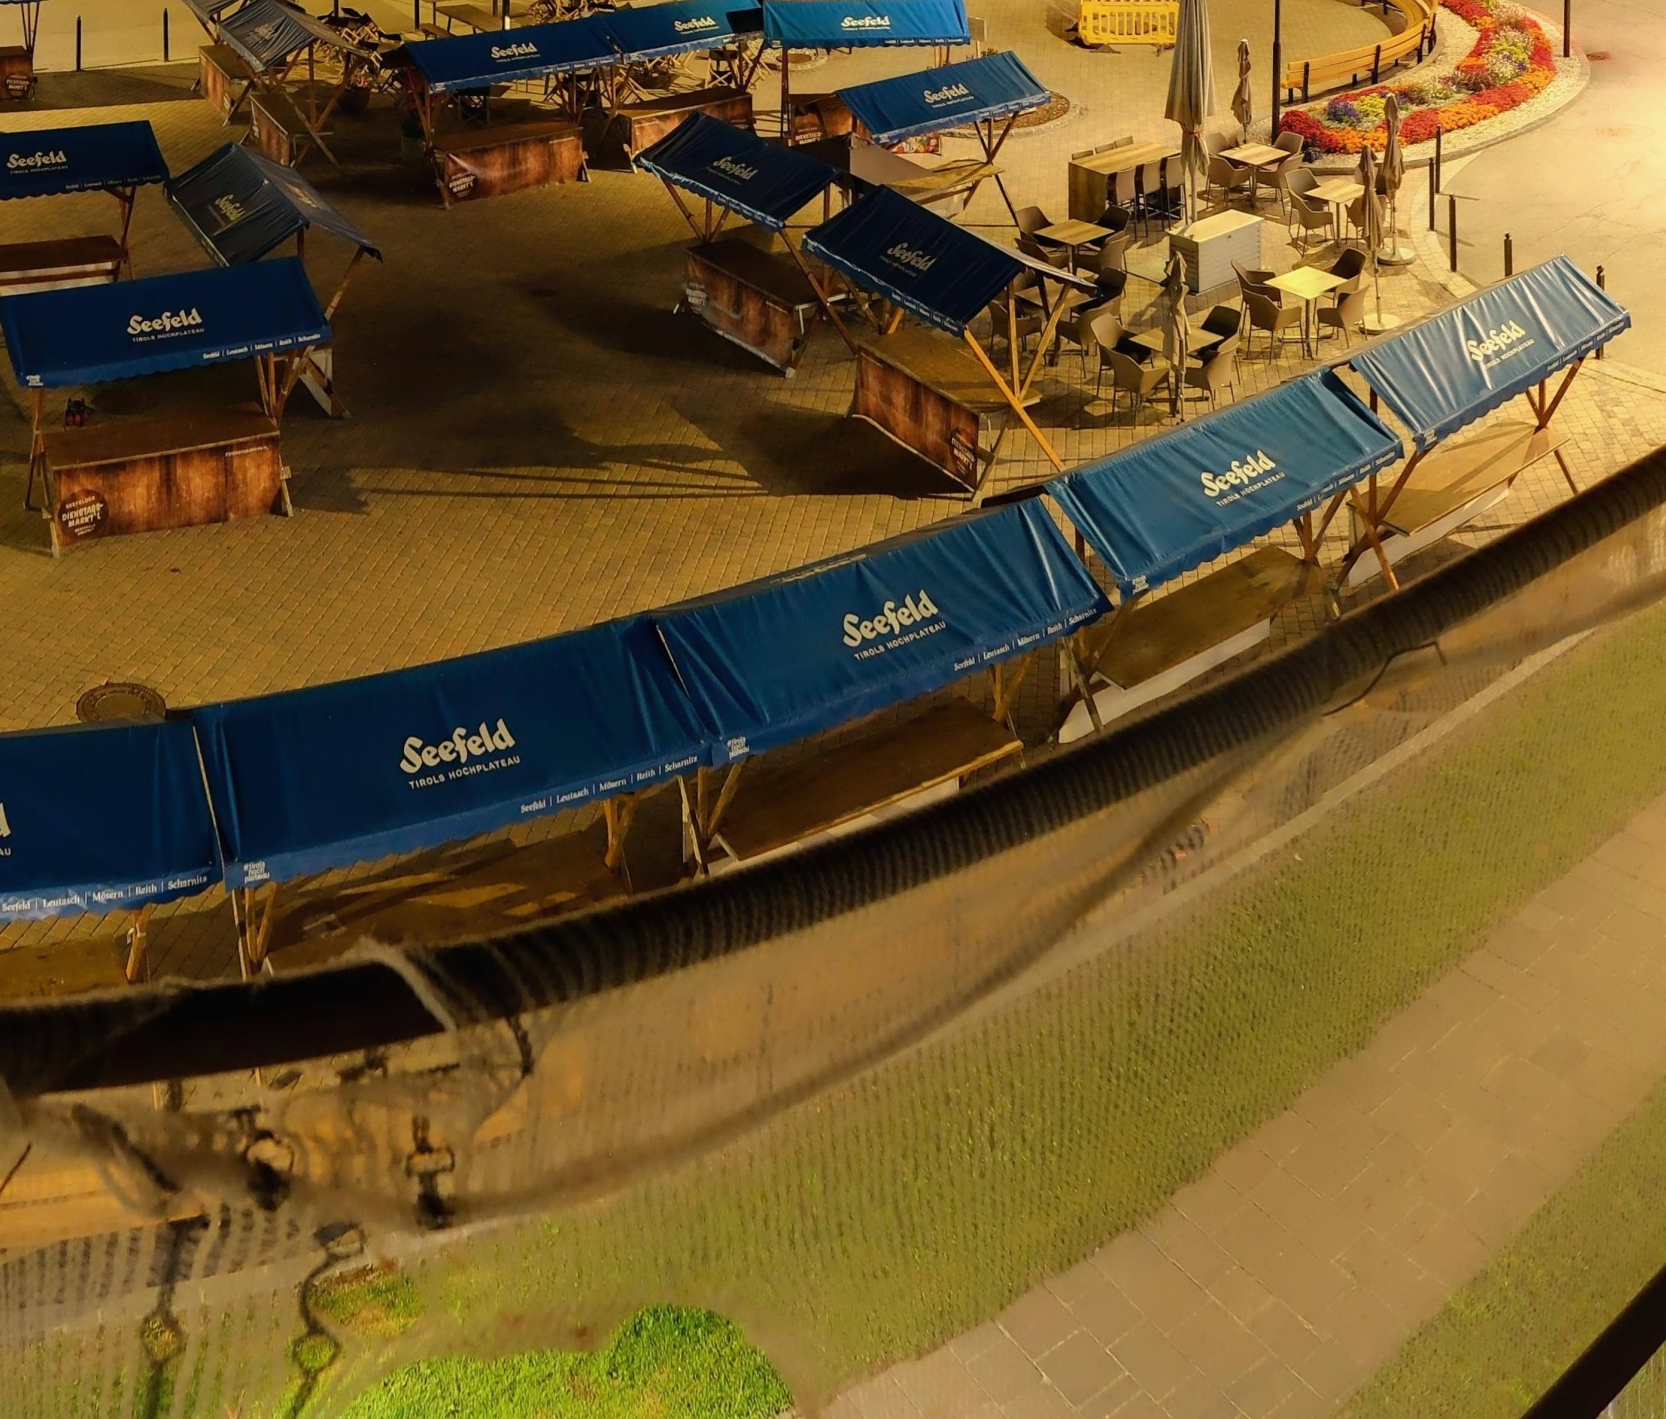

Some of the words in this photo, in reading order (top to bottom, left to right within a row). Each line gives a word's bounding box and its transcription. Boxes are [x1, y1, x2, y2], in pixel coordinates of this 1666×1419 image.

[674, 16, 717, 31] Seefeld
[841, 15, 891, 28] Seefeld
[491, 42, 538, 59] Seefeld
[924, 82, 970, 104] Seefeld
[6, 149, 67, 169] Seefeld
[713, 155, 758, 180] Seefeld
[887, 242, 937, 272] Seefeld
[127, 307, 202, 335] Seefeld
[1466, 319, 1526, 362] Seefeld
[1200, 448, 1277, 498] Seefeld
[843, 588, 939, 648] Seefeld
[854, 644, 886, 662] TIROLS
[886, 620, 947, 650] HOCHPLATEAU
[399, 717, 516, 774] Seefeld
[409, 773, 446, 790] TIROLS
[448, 754, 521, 781] HOCHPLATEAU
[520, 800, 546, 815] Seefeld
[556, 787, 590, 805] Leutasch
[599, 777, 628, 792] Mösern
[636, 768, 656, 781] Reith
[664, 754, 698, 773] Scharnitz
[1, 899, 31, 912] Seefeld
[42, 894, 81, 909] Leutasch
[92, 890, 124, 903] Mösern
[135, 884, 158, 896] Reith
[167, 874, 208, 891] Scharnitz
